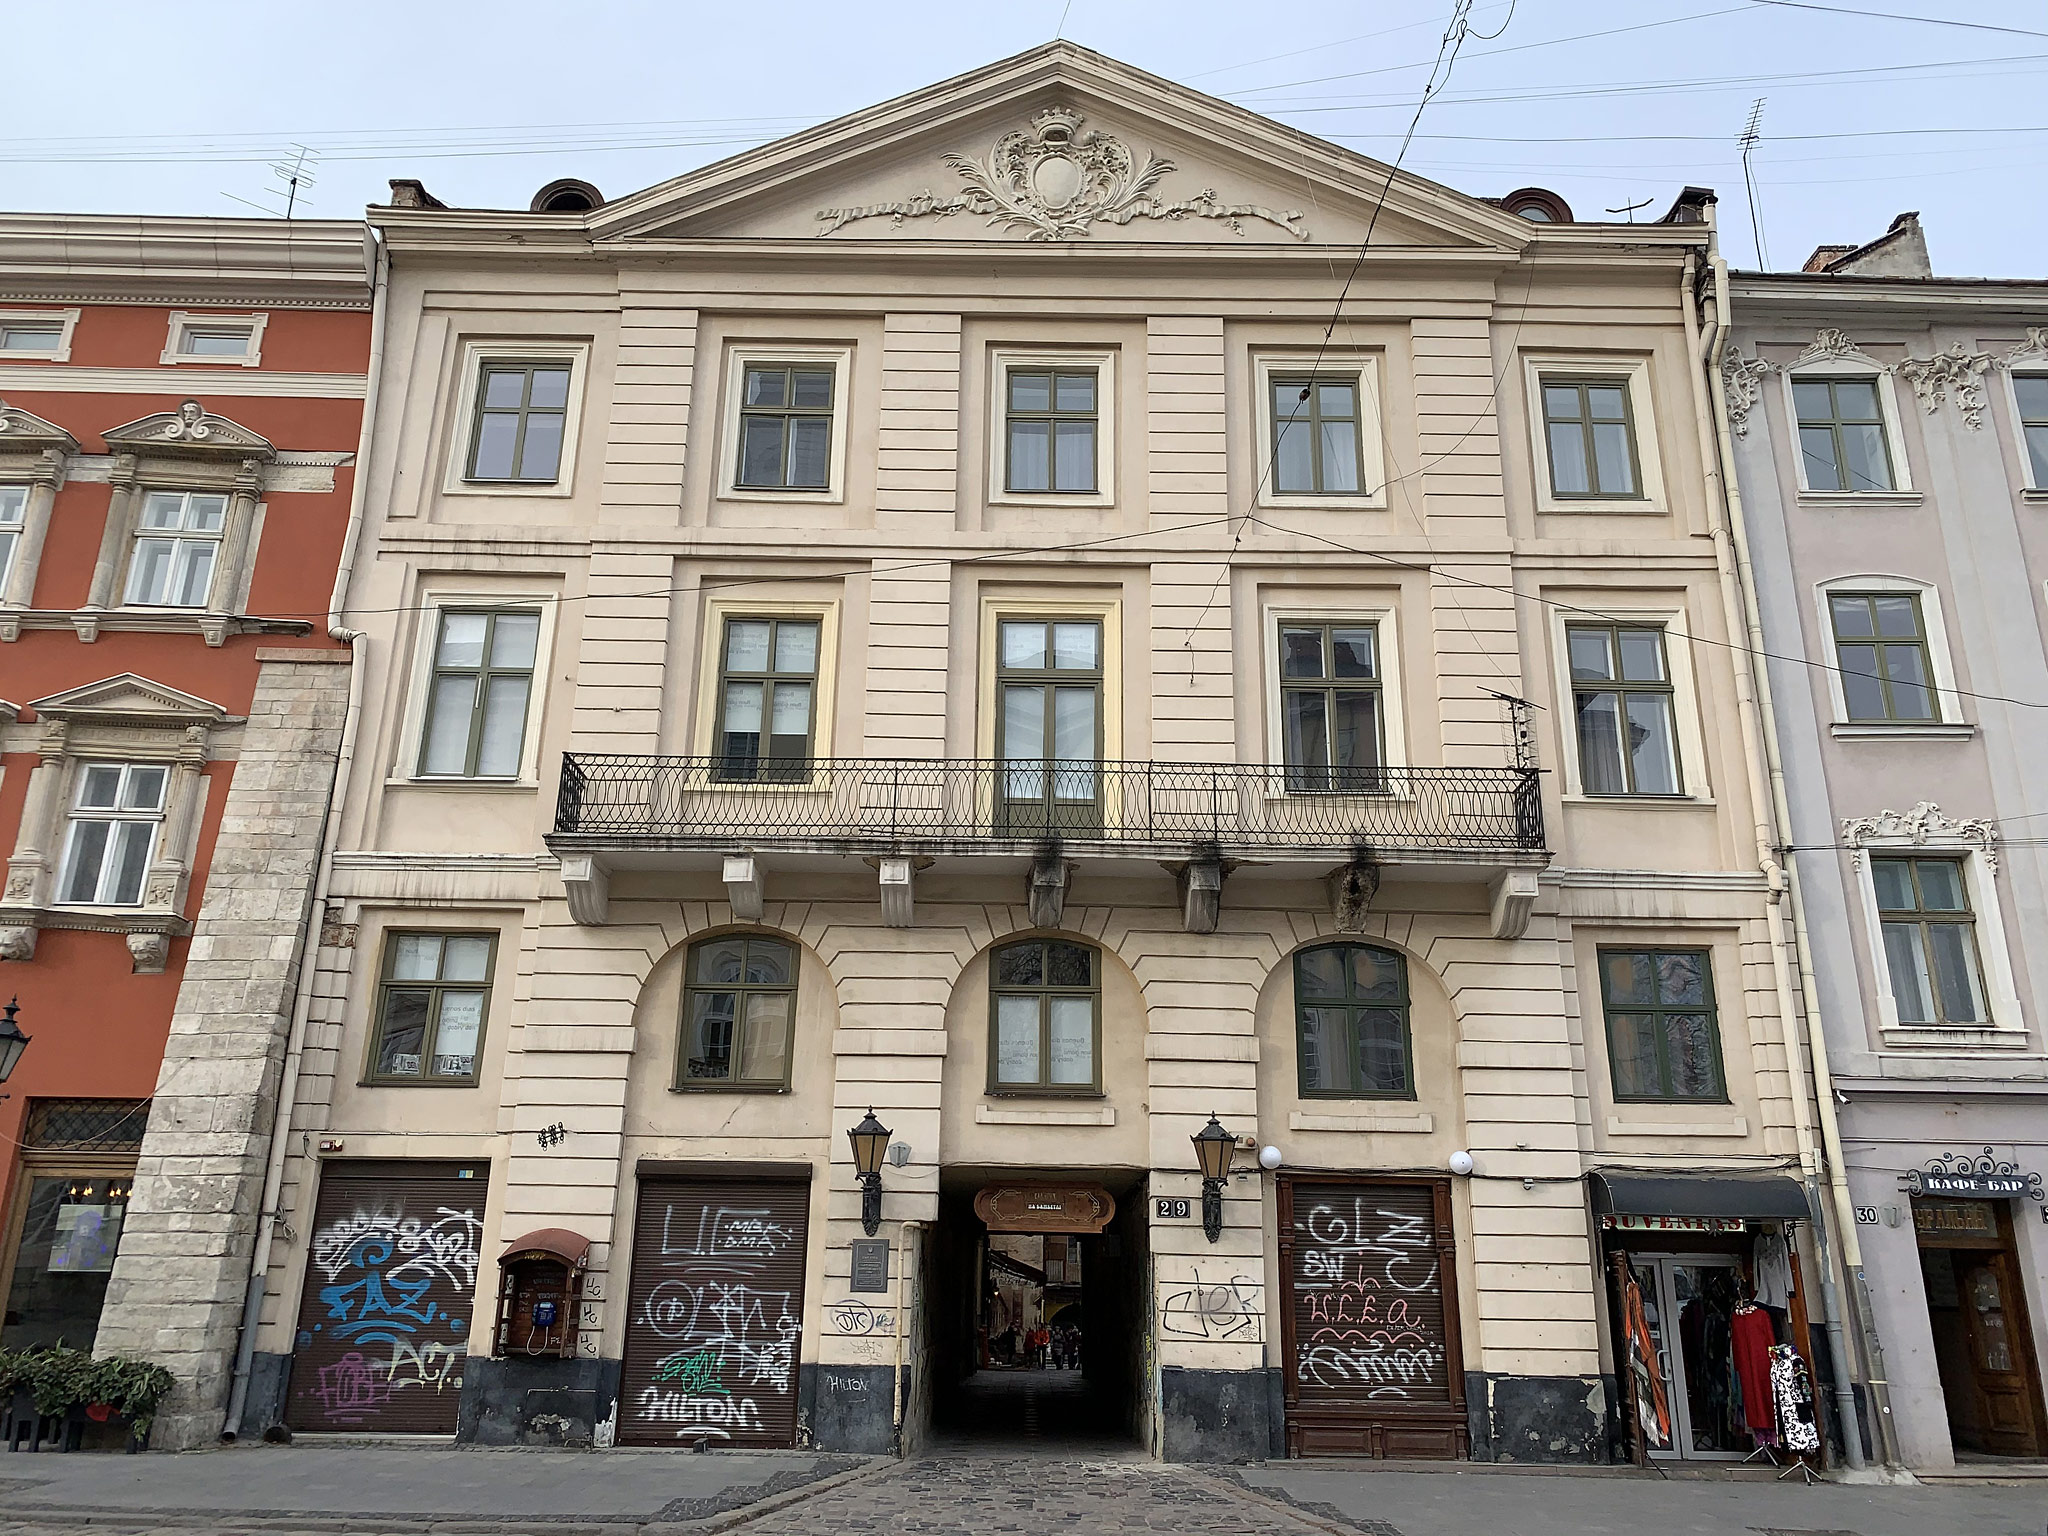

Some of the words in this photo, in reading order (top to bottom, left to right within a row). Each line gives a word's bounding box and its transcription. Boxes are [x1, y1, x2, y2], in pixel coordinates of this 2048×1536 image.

[1927, 1178, 2024, 1192] КАФЕ-БАР
[1159, 1201, 1187, 1216] 29
[1857, 1207, 1877, 1223] 30
